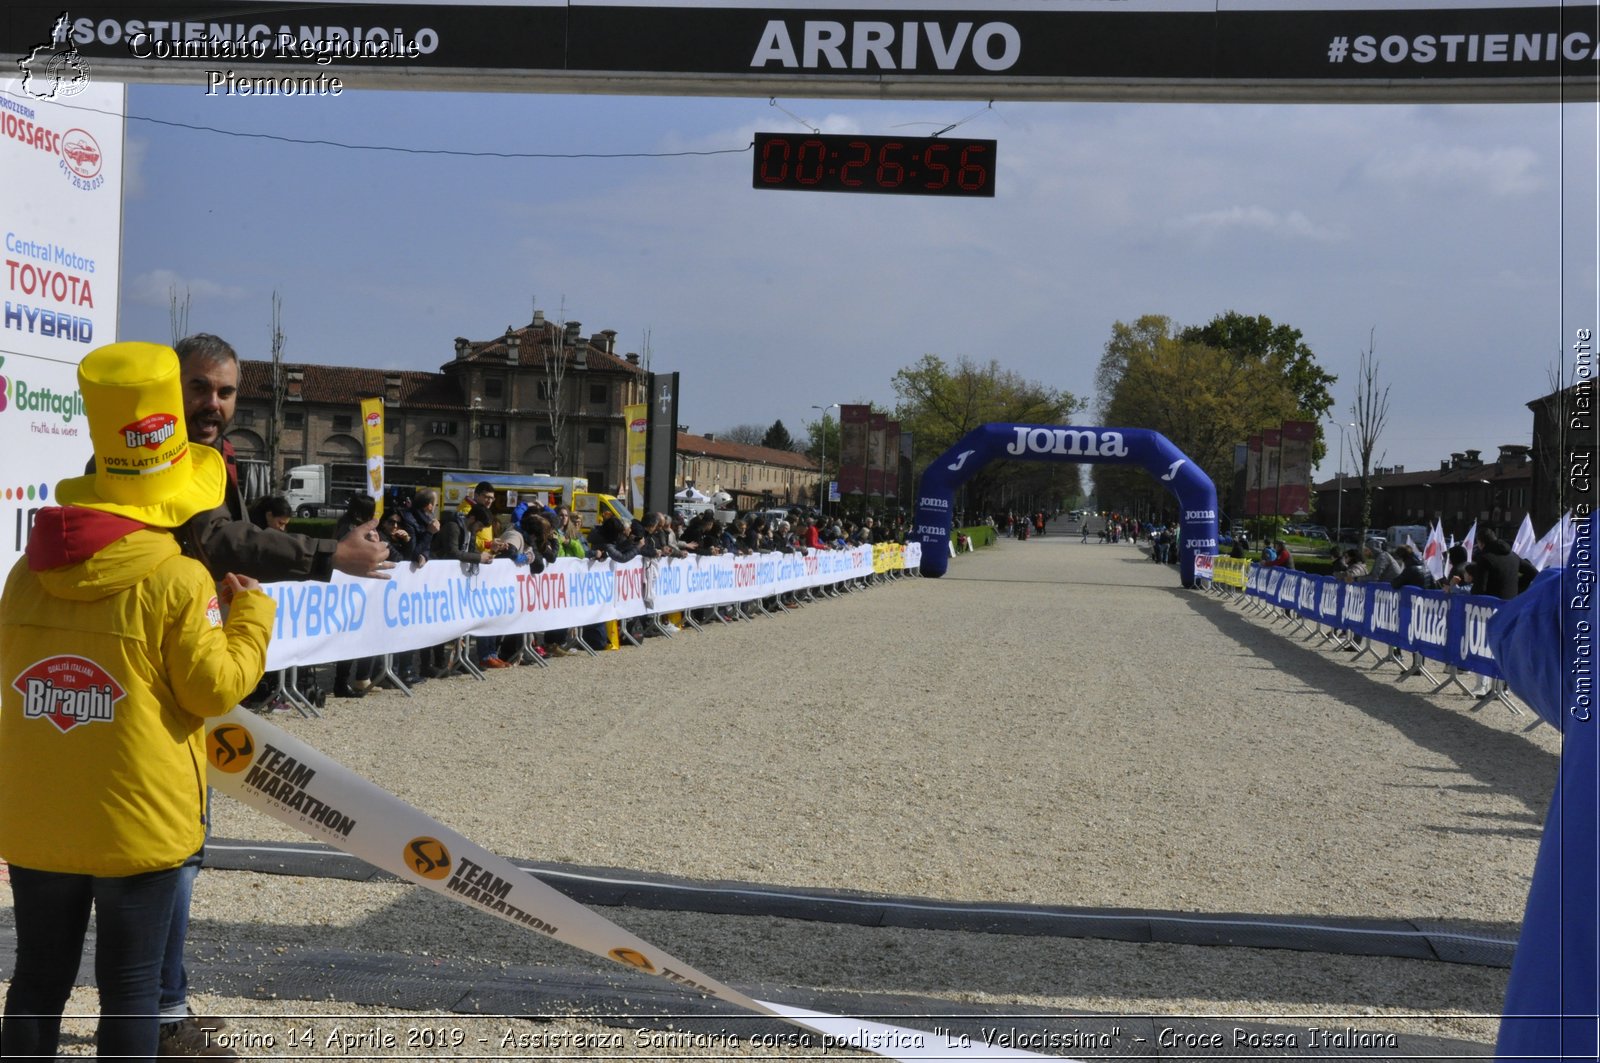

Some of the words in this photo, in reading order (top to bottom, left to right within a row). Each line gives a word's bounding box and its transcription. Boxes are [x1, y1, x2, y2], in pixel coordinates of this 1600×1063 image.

[750, 20, 1021, 71] ARRIVO
[1327, 31, 1600, 64] #SOSTIENIC
[760, 138, 987, 191] 00:26:56
[6, 232, 52, 262] Central
[55, 246, 95, 273] Motors
[6, 259, 94, 309] TOYOTA
[5, 301, 93, 344] HYBRID
[125, 419, 175, 449] Biraghi
[103, 456, 128, 467] 100%
[132, 455, 160, 467] LATTE
[266, 583, 366, 640] HYBRID
[383, 580, 456, 628] Central
[458, 577, 515, 620] Motors
[516, 573, 567, 612] TOYOTA
[570, 571, 614, 605] HYBRID
[616, 567, 645, 603] TOYOT
[687, 564, 712, 593] Central
[26, 678, 112, 722] Biraghi
[256, 744, 316, 789] TEAM
[240, 784, 260, 797] run
[267, 798, 293, 814] your
[300, 816, 347, 842] passion
[244, 764, 357, 837] MARATHON
[454, 857, 513, 900] TEAM
[446, 876, 558, 935] MARATHON
